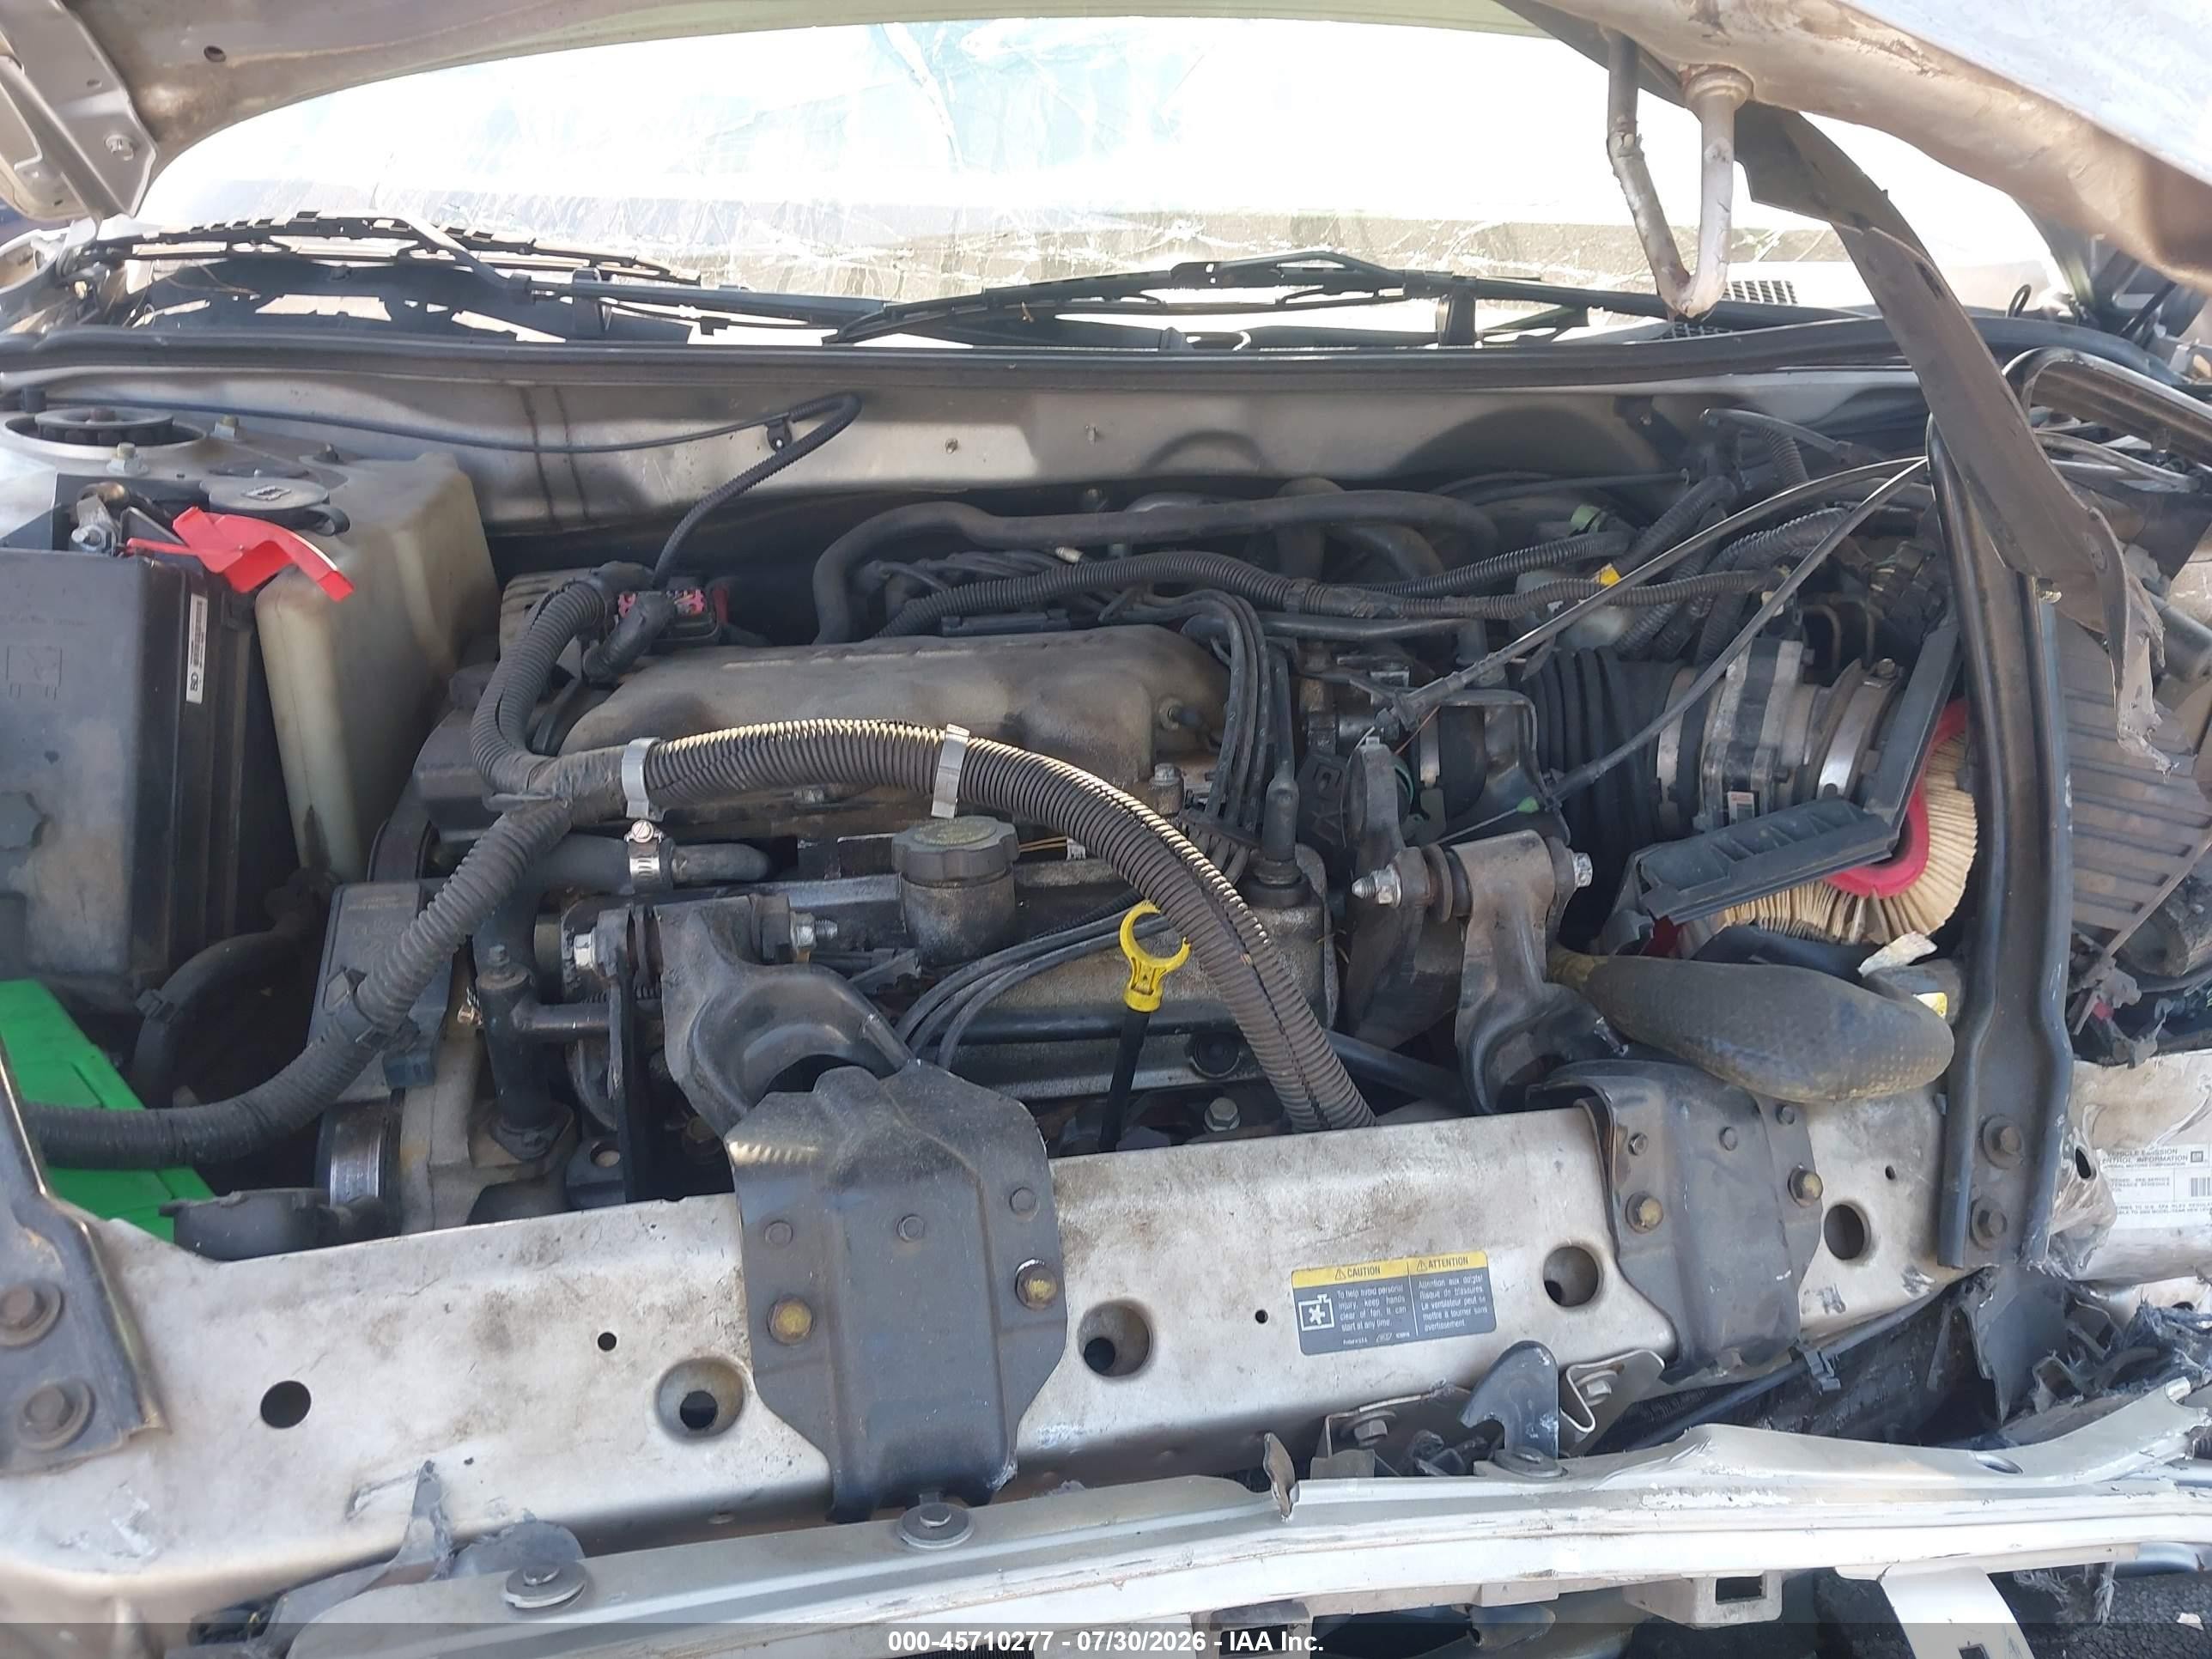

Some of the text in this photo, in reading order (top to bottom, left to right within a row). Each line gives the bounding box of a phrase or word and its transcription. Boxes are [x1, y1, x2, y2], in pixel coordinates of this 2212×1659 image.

[1428, 1256, 1468, 1268] ATTENTION
[1347, 1266, 1381, 1278] CAUTION
[1419, 1279, 1445, 1289] Attention
[1449, 1278, 1460, 1286] aux
[1337, 1285, 1404, 1299] To help avoid personal
[1419, 1291, 1441, 1300] Risque
[1443, 1289, 1451, 1297] de
[1364, 1297, 1380, 1308] keep
[1386, 1295, 1406, 1304] hands
[1421, 1302, 1429, 1310] Le
[1431, 1298, 1462, 1309] ventilateur
[1463, 1296, 1477, 1306] peut
[1340, 1312, 1355, 1321] clear
[1360, 1310, 1366, 1319] of
[1370, 1308, 1383, 1317] fan.
[1423, 1311, 1443, 1321] mettre
[1450, 1308, 1471, 1318] tourner
[1341, 1323, 1356, 1332] start
[1357, 1322, 1364, 1330] at
[1364, 1321, 1376, 1331] any
